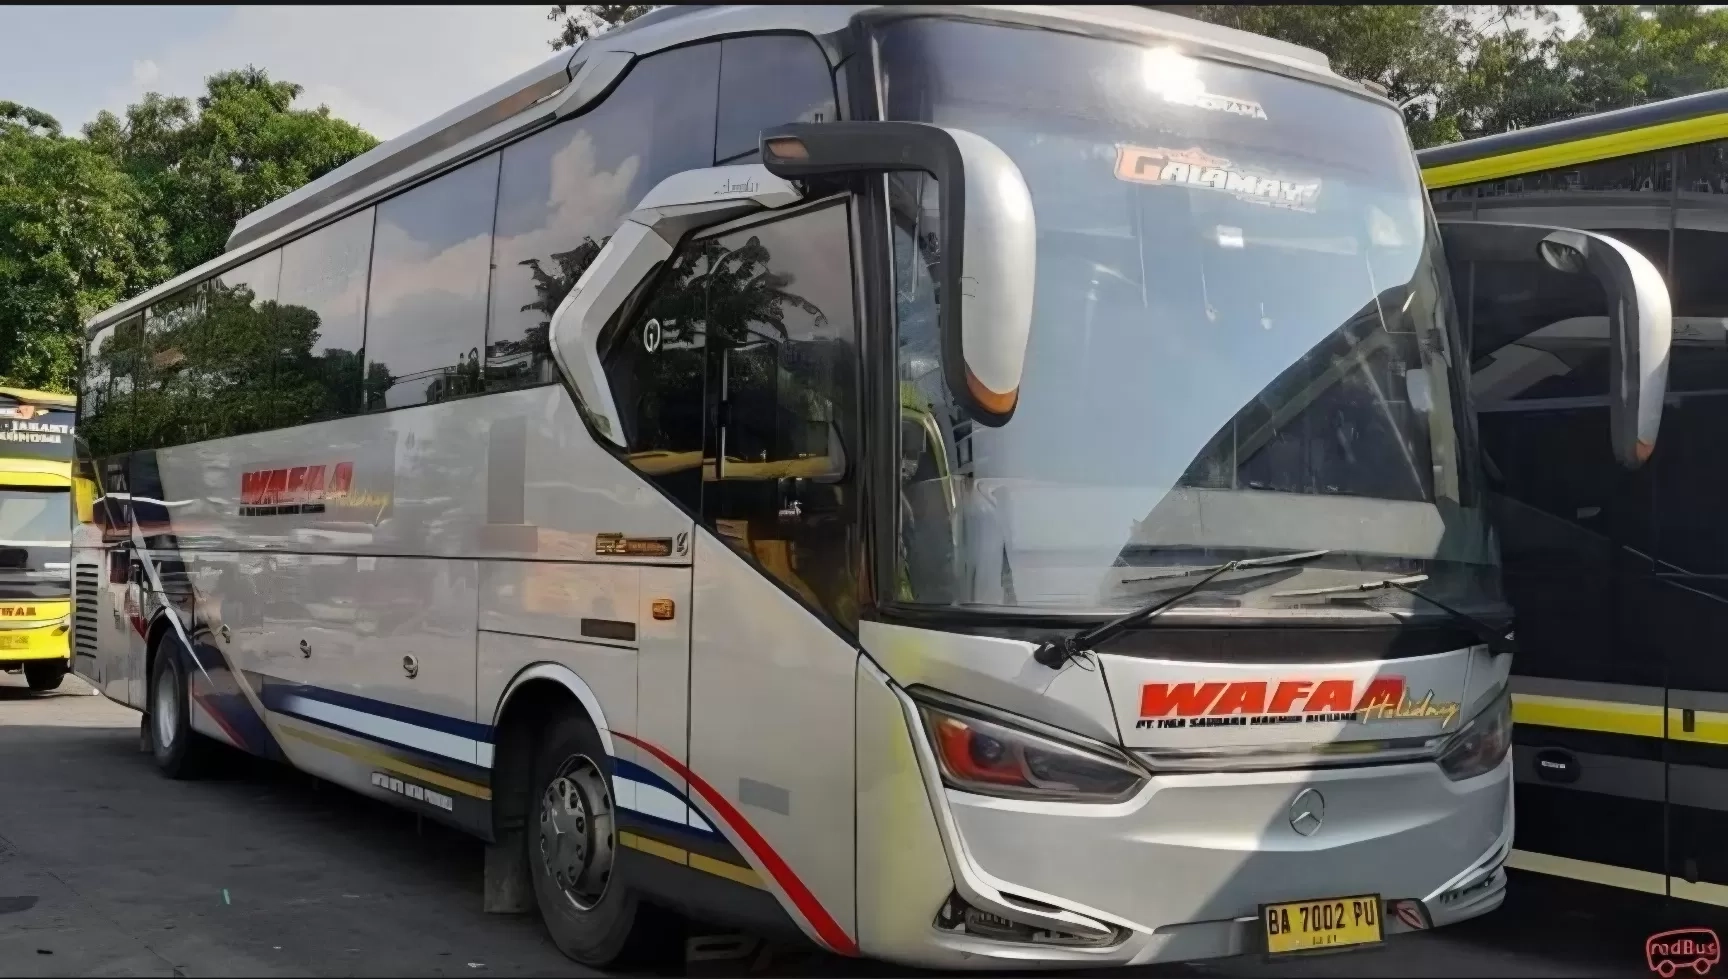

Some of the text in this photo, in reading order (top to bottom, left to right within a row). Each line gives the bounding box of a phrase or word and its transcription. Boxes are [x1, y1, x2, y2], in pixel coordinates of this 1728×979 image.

[1140, 679, 1405, 717] WAFAA
[1355, 687, 1460, 730] Holiday
[1268, 899, 1375, 935] BA 7002 PU
